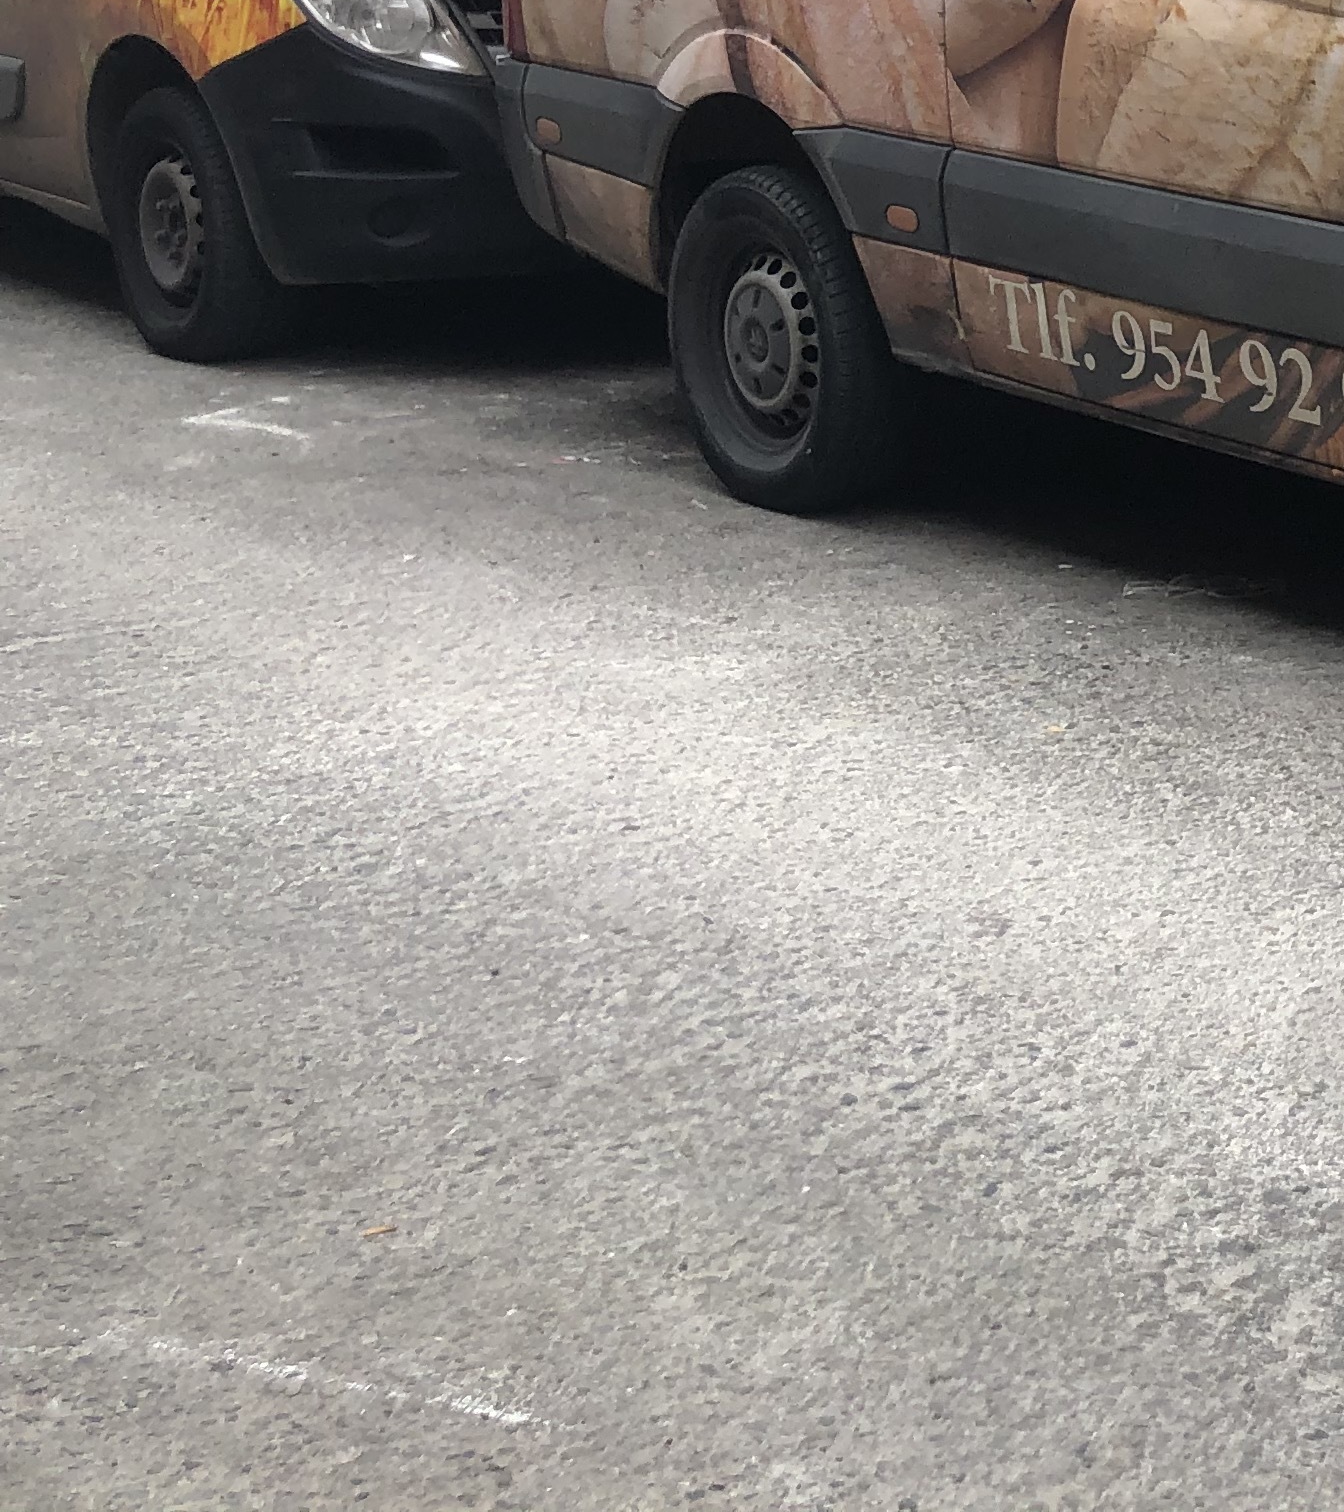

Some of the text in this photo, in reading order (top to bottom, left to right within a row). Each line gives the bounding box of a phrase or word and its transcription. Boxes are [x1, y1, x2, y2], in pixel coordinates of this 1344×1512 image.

[988, 275, 1096, 372] Tlf.
[1112, 309, 1225, 404] 954
[1240, 338, 1322, 426] 92
